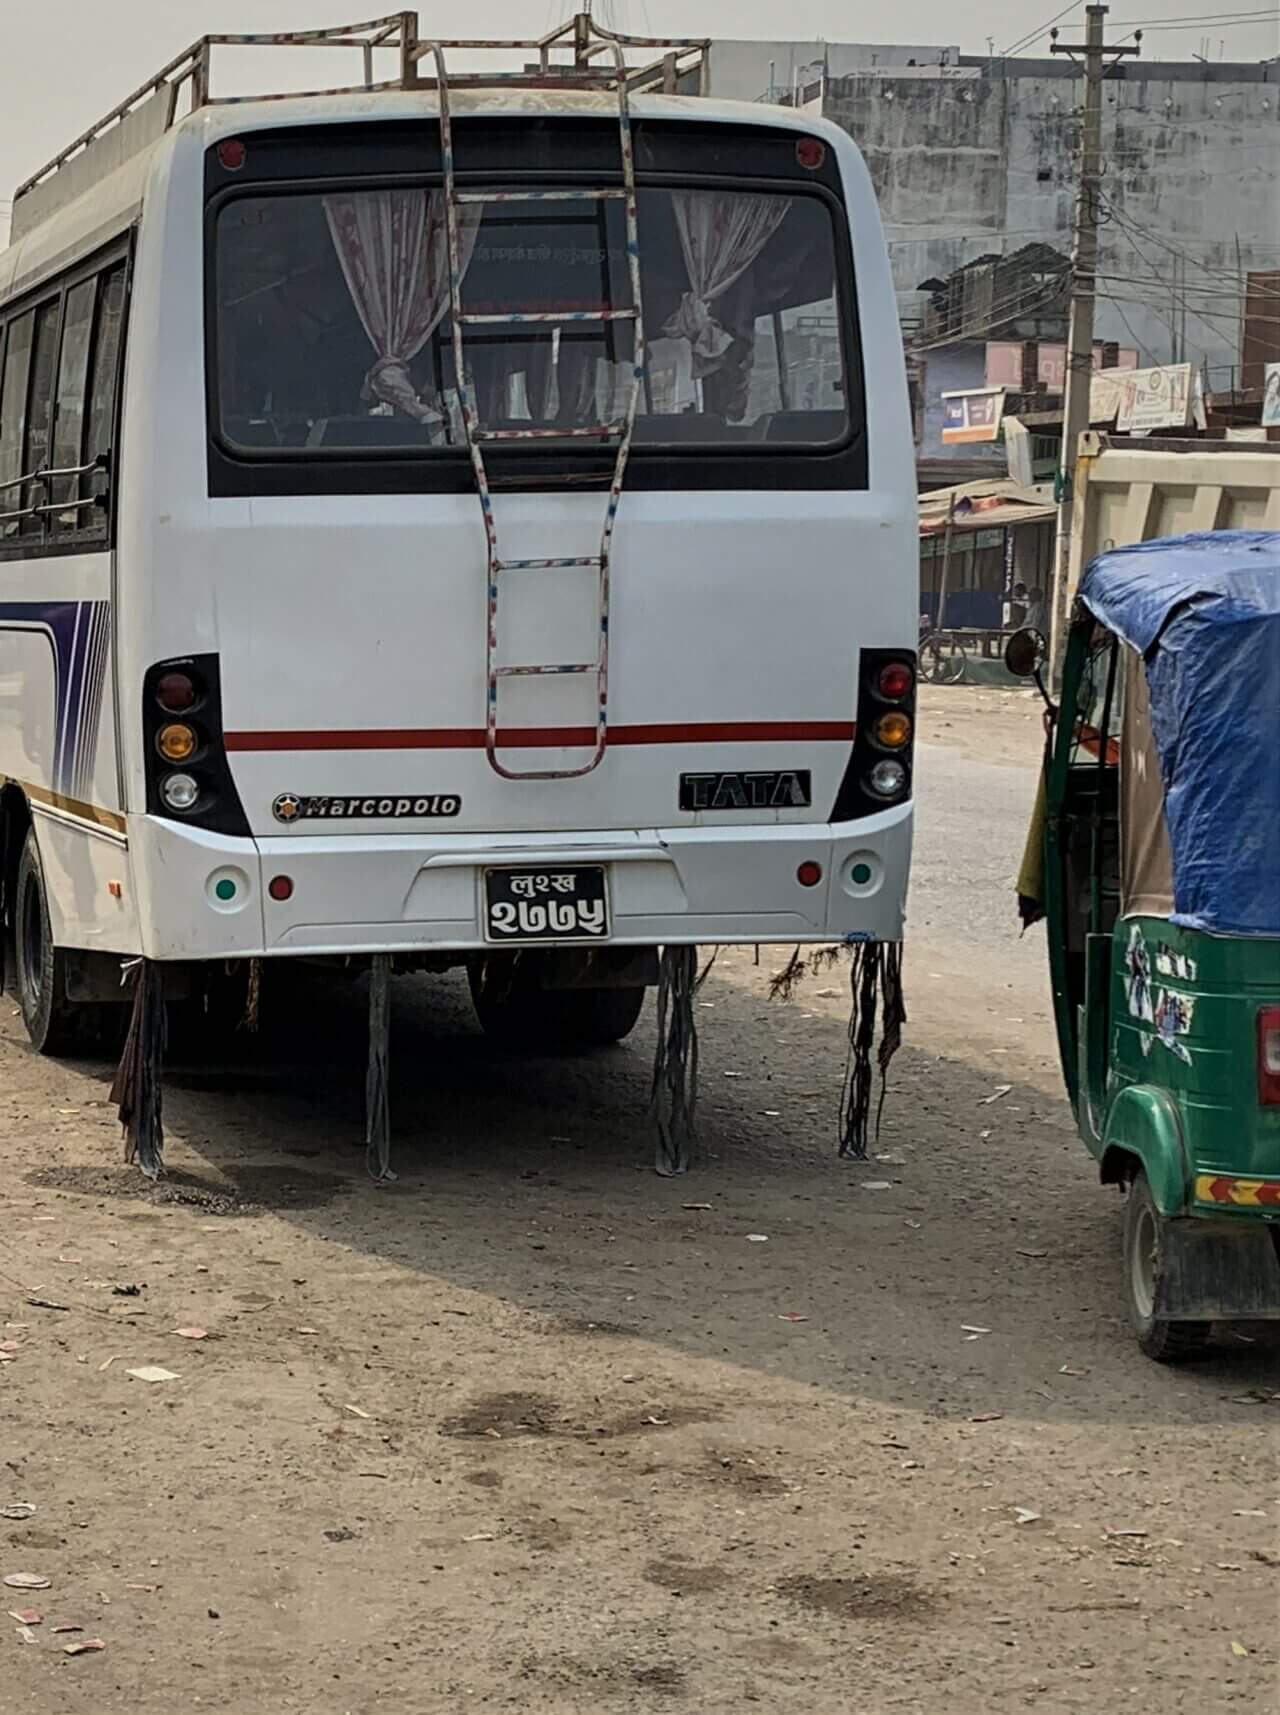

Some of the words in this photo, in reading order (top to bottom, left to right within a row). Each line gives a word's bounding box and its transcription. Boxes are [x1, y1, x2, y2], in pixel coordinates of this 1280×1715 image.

[305, 794, 457, 817] Marcopolo
[684, 772, 808, 807] TATA
[490, 899, 605, 934] २७७५
